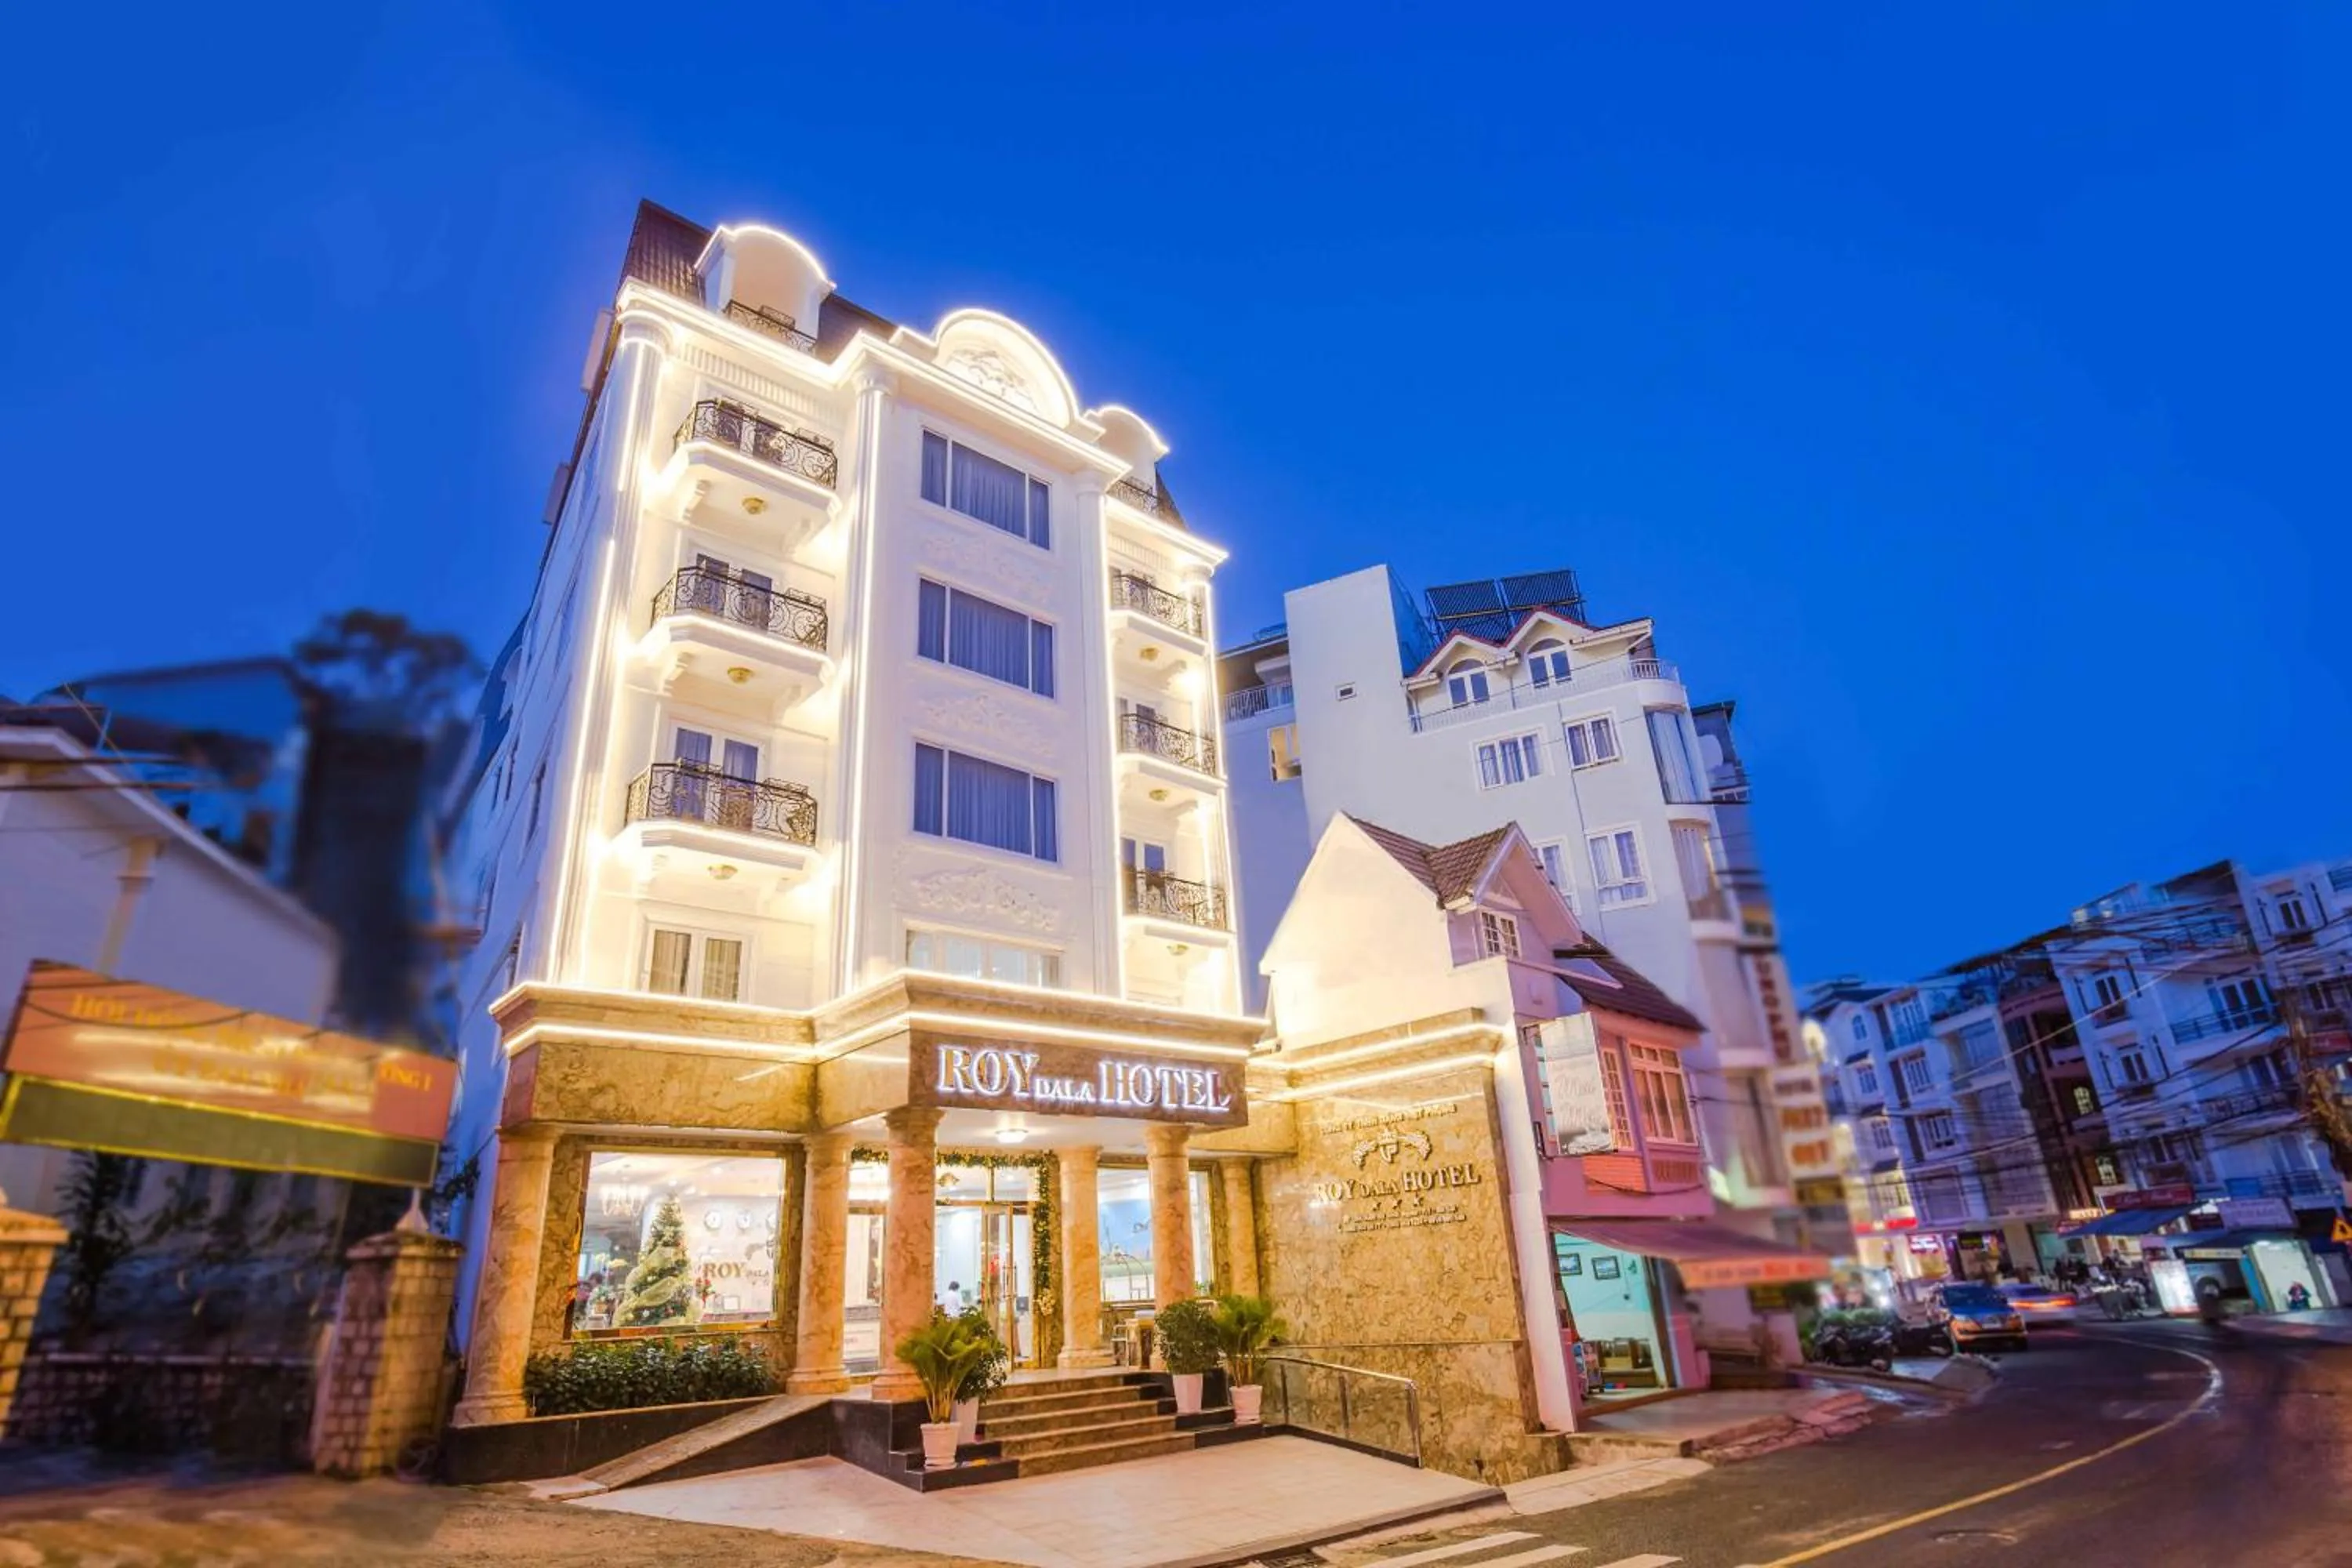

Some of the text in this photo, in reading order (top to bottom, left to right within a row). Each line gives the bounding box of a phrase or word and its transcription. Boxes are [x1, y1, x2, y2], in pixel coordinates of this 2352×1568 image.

[936, 1045, 1231, 1112] ROY DALA HOTEL
[1315, 1179, 1356, 1203] ROY
[1402, 1163, 1481, 1192] HOTEL
[702, 1261, 746, 1278] ROY
